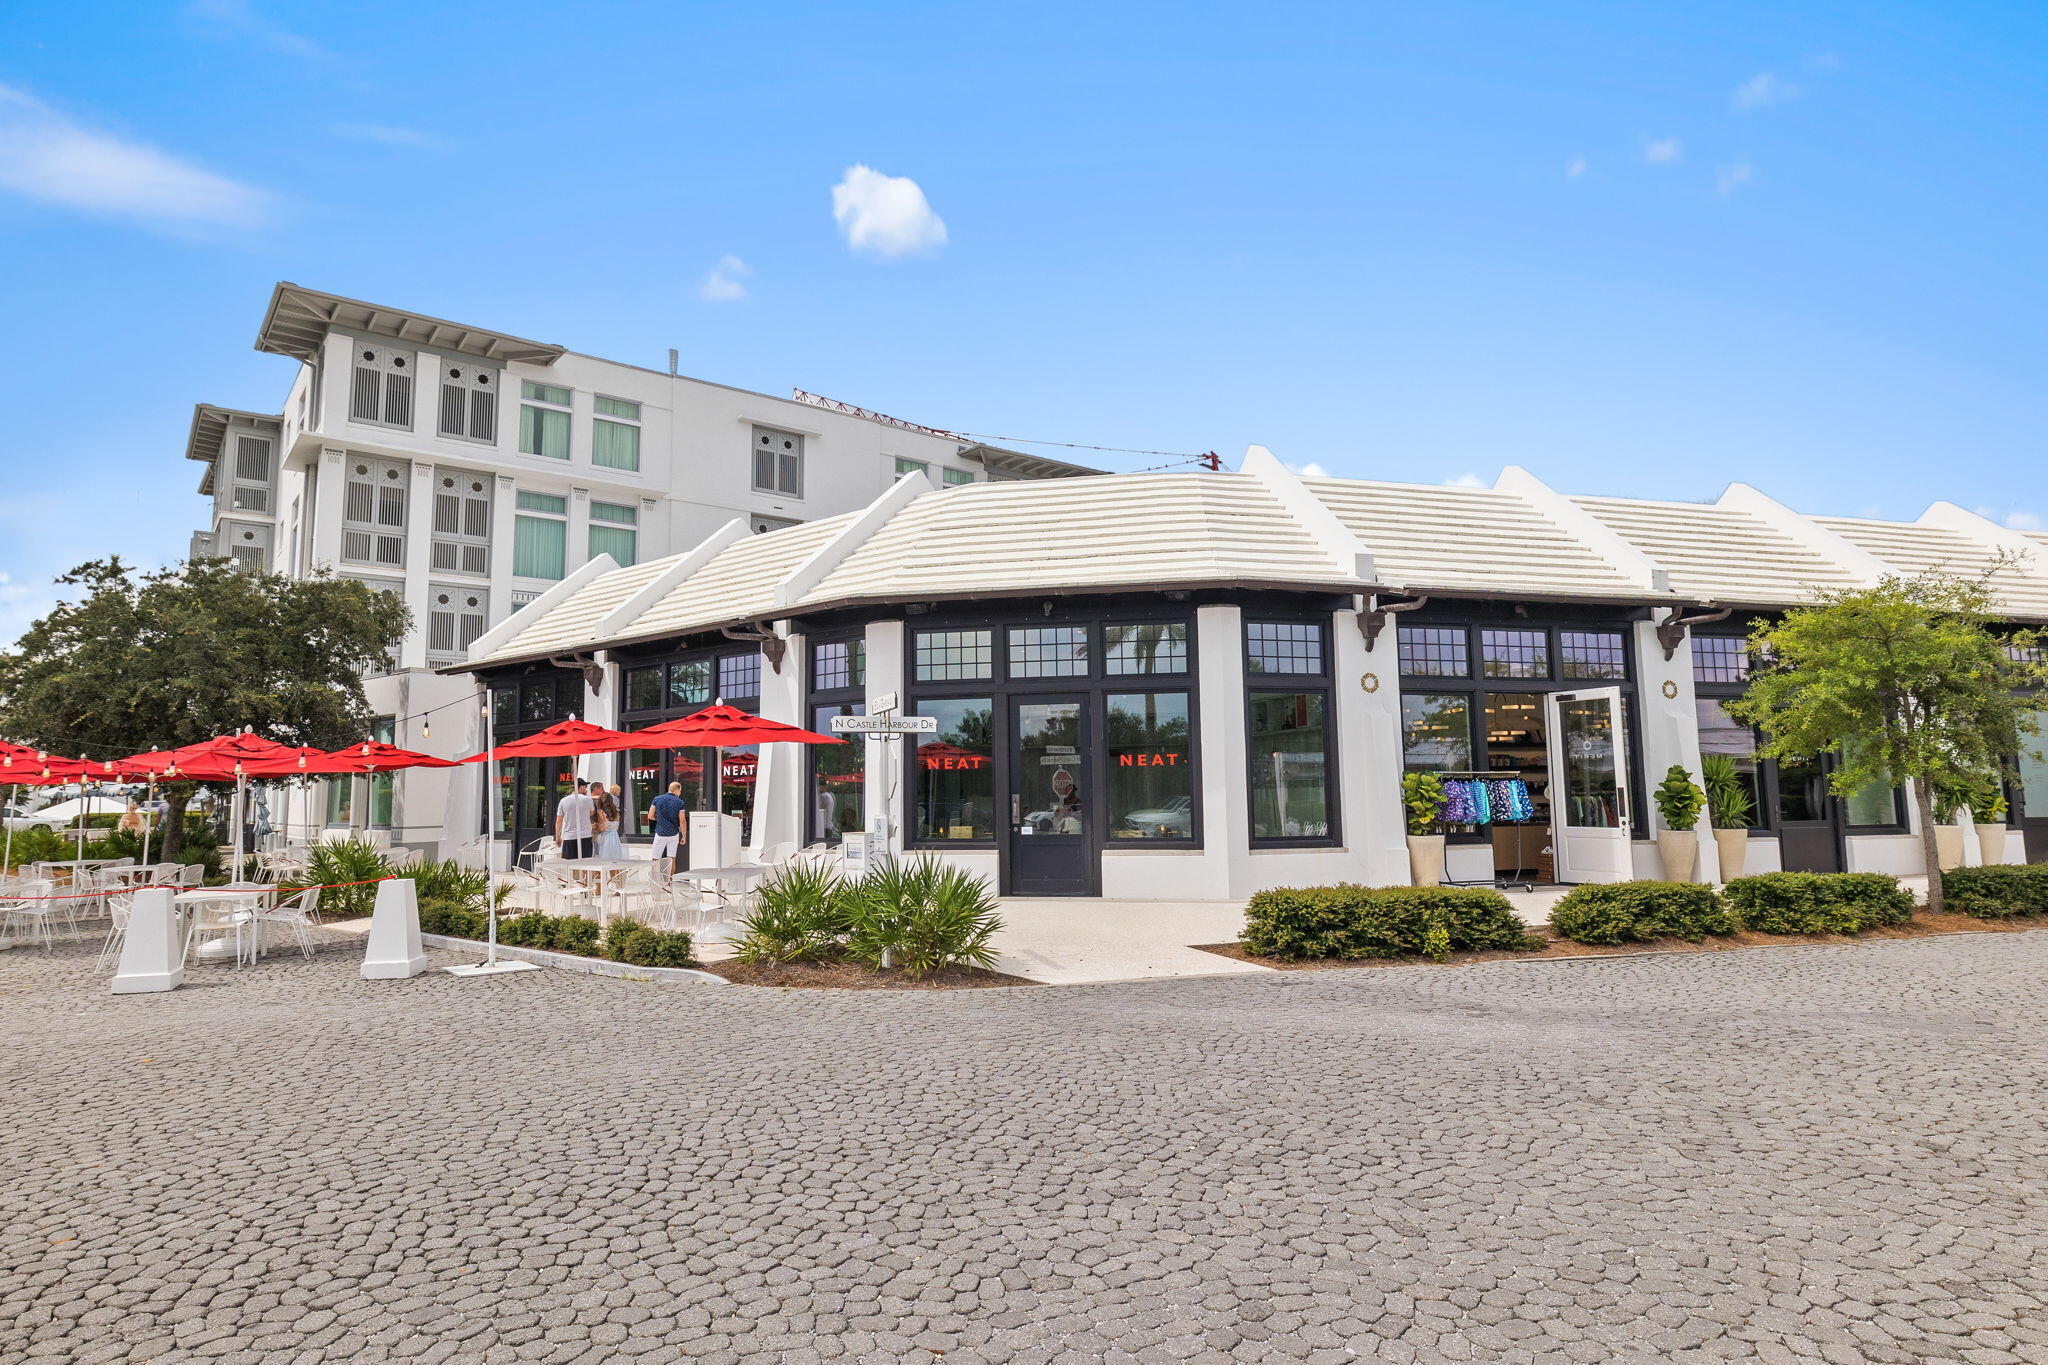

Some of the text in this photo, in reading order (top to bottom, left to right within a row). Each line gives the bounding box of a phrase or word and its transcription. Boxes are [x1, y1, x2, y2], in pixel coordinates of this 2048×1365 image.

[835, 719, 843, 728] N
[847, 718, 876, 729] CASTLE
[880, 719, 917, 729] HARBOUR
[926, 757, 982, 770] NEAT
[1119, 753, 1178, 767] NEAT
[628, 769, 655, 780] NEAT
[723, 764, 755, 776] NEAT
